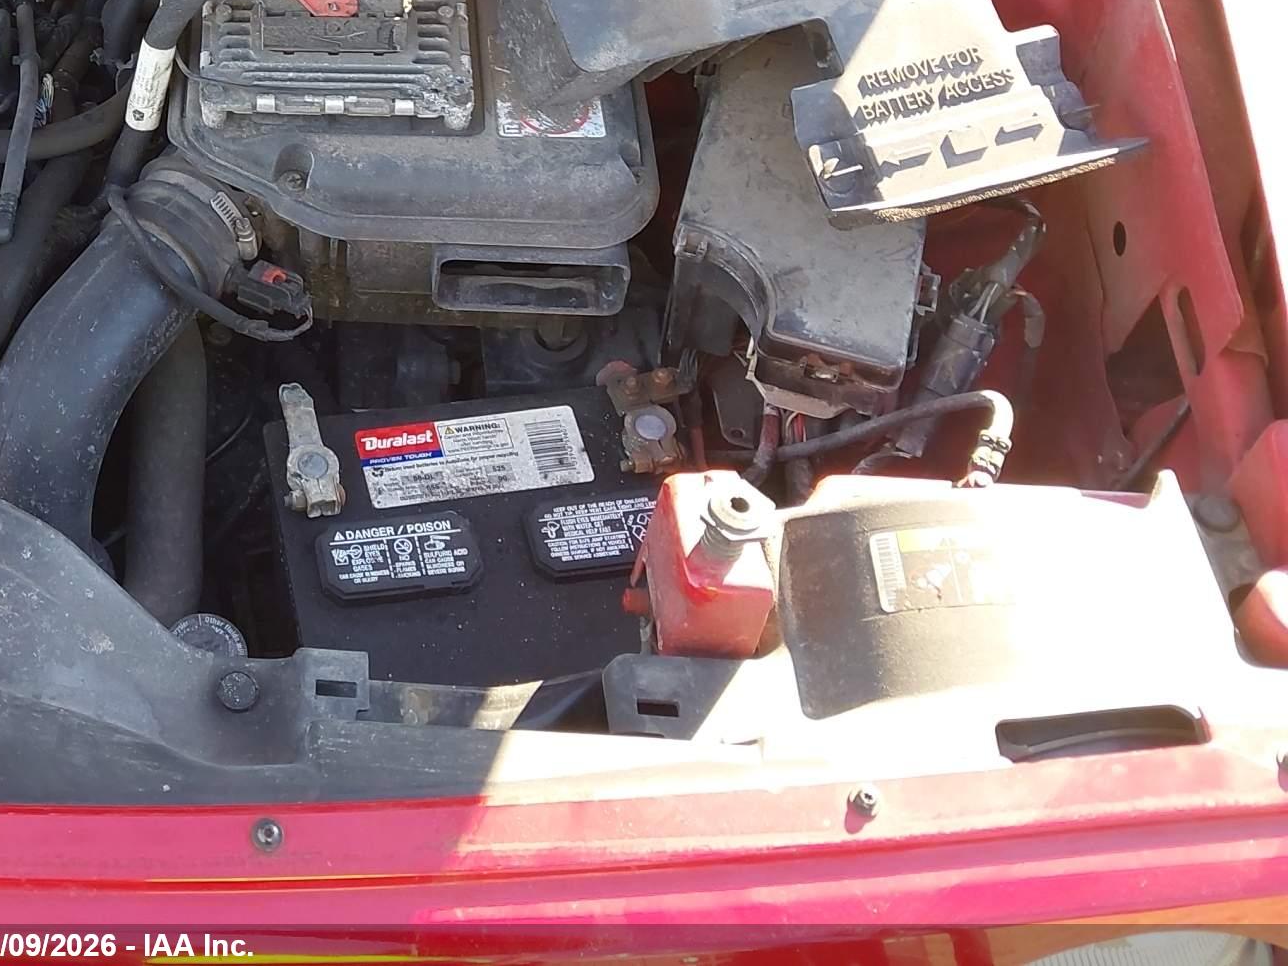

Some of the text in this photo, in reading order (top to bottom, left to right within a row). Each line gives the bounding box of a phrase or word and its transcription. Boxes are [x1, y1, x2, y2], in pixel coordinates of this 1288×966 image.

[864, 46, 984, 90] REMOVE FOR
[861, 67, 1016, 121] BATTERY ACCESS
[454, 422, 500, 434] WARNING:
[361, 430, 433, 451] Duralast
[370, 456, 402, 464] PROVEN
[346, 520, 451, 540] DANGER / POISON
[204, 616, 224, 626] Other
